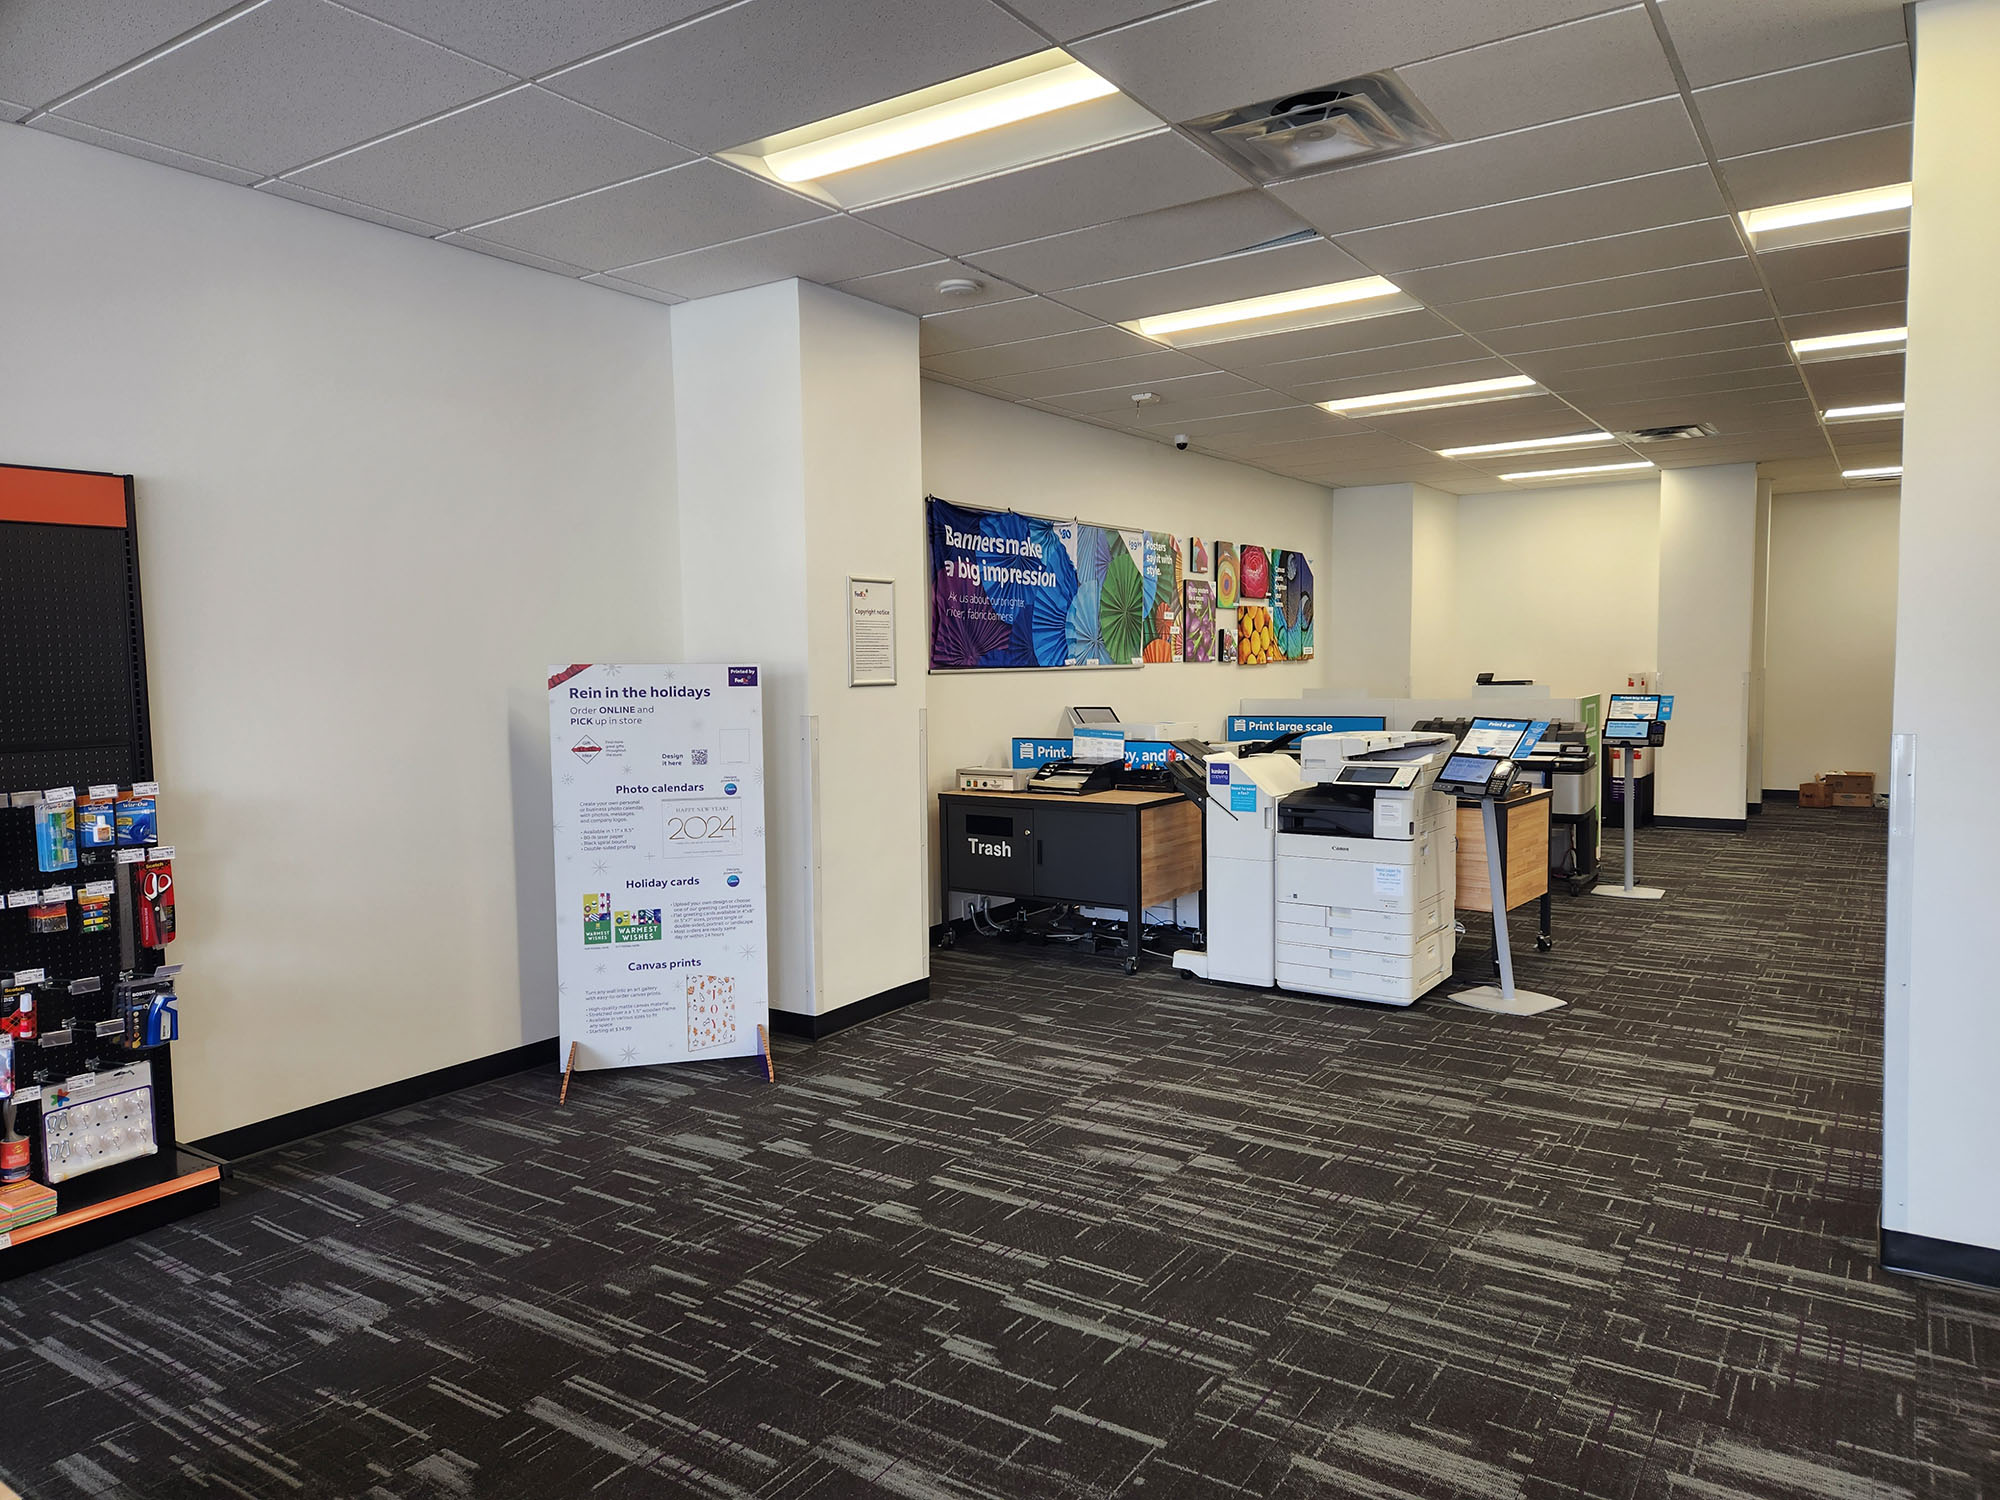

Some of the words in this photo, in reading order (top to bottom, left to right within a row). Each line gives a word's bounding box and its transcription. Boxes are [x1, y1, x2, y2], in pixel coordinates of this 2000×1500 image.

[944, 524, 1005, 553] Banners
[1005, 537, 1043, 559] make
[1146, 540, 1166, 552] Posters
[1160, 554, 1172, 564] with
[944, 560, 954, 577] a
[958, 555, 980, 586] big
[982, 559, 1056, 588] impression
[960, 595, 968, 603] us
[970, 594, 989, 605] about
[854, 608, 876, 616] Copyright
[967, 608, 987, 620] fabric
[569, 687, 601, 699] Rein
[605, 687, 618, 698] in
[622, 686, 647, 698] the
[650, 686, 711, 700] holidays
[570, 707, 597, 715] Order
[599, 706, 635, 714] ONLINE
[609, 717, 617, 725] in
[1249, 721, 1274, 731] Print
[1276, 721, 1303, 732] large
[1305, 722, 1333, 732] scale
[1142, 749, 1167, 761] and
[615, 785, 649, 794] Photo
[651, 783, 704, 794] calendars
[668, 815, 737, 840] 2024
[968, 838, 1011, 858] Trash
[626, 879, 668, 889] Holiday
[670, 877, 700, 886] cards
[618, 926, 658, 934] WARMEST
[622, 933, 654, 941] WISHES
[628, 961, 667, 971] Canvas
[669, 958, 702, 971] prints
[132, 989, 156, 997] BOSTITCH
